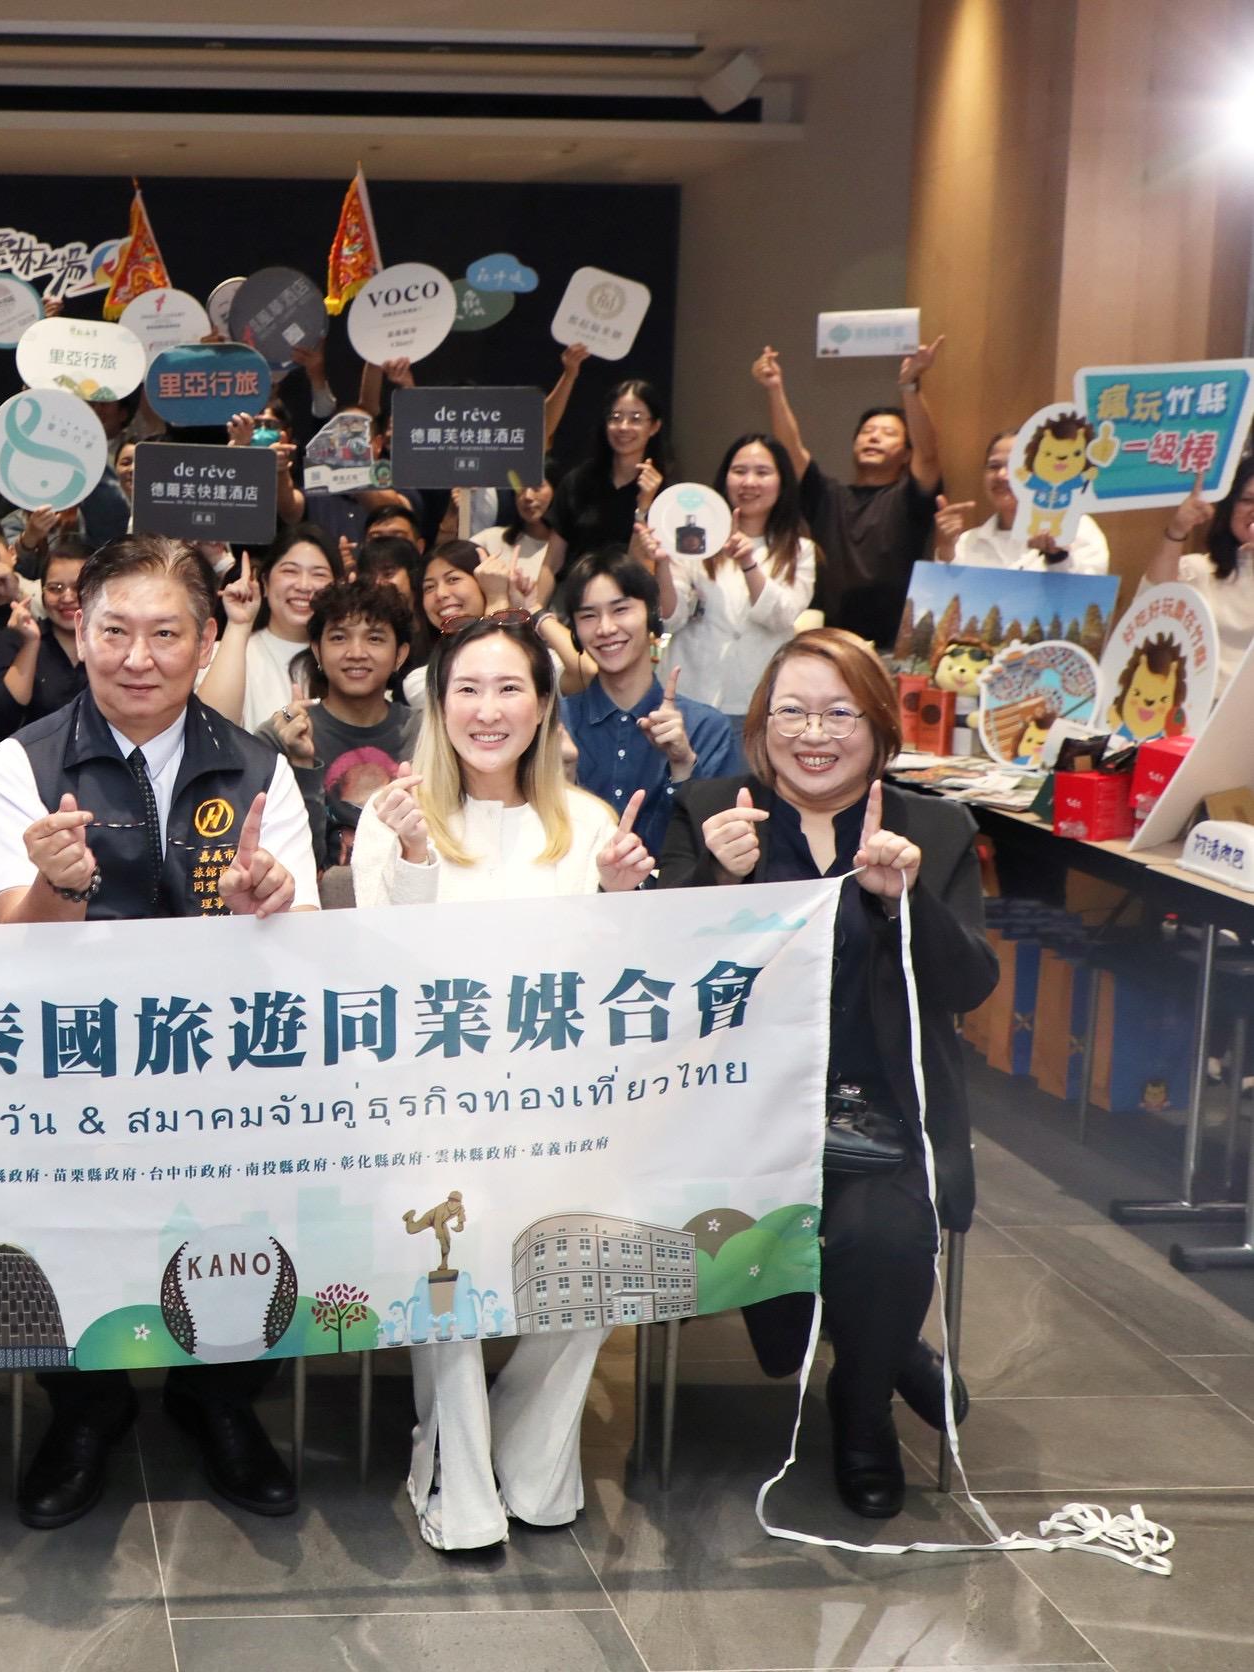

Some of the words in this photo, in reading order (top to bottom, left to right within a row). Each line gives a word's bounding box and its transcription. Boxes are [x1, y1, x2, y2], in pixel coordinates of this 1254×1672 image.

[367, 280, 440, 309] VOCO
[49, 348, 118, 371] 里亞行旅
[158, 370, 260, 399] 里亞行旅
[434, 405, 457, 422] de
[1121, 430, 1219, 474] 一級棒
[173, 462, 195, 477] de
[77, 1105, 107, 1136] &
[187, 1252, 271, 1281] KANO
